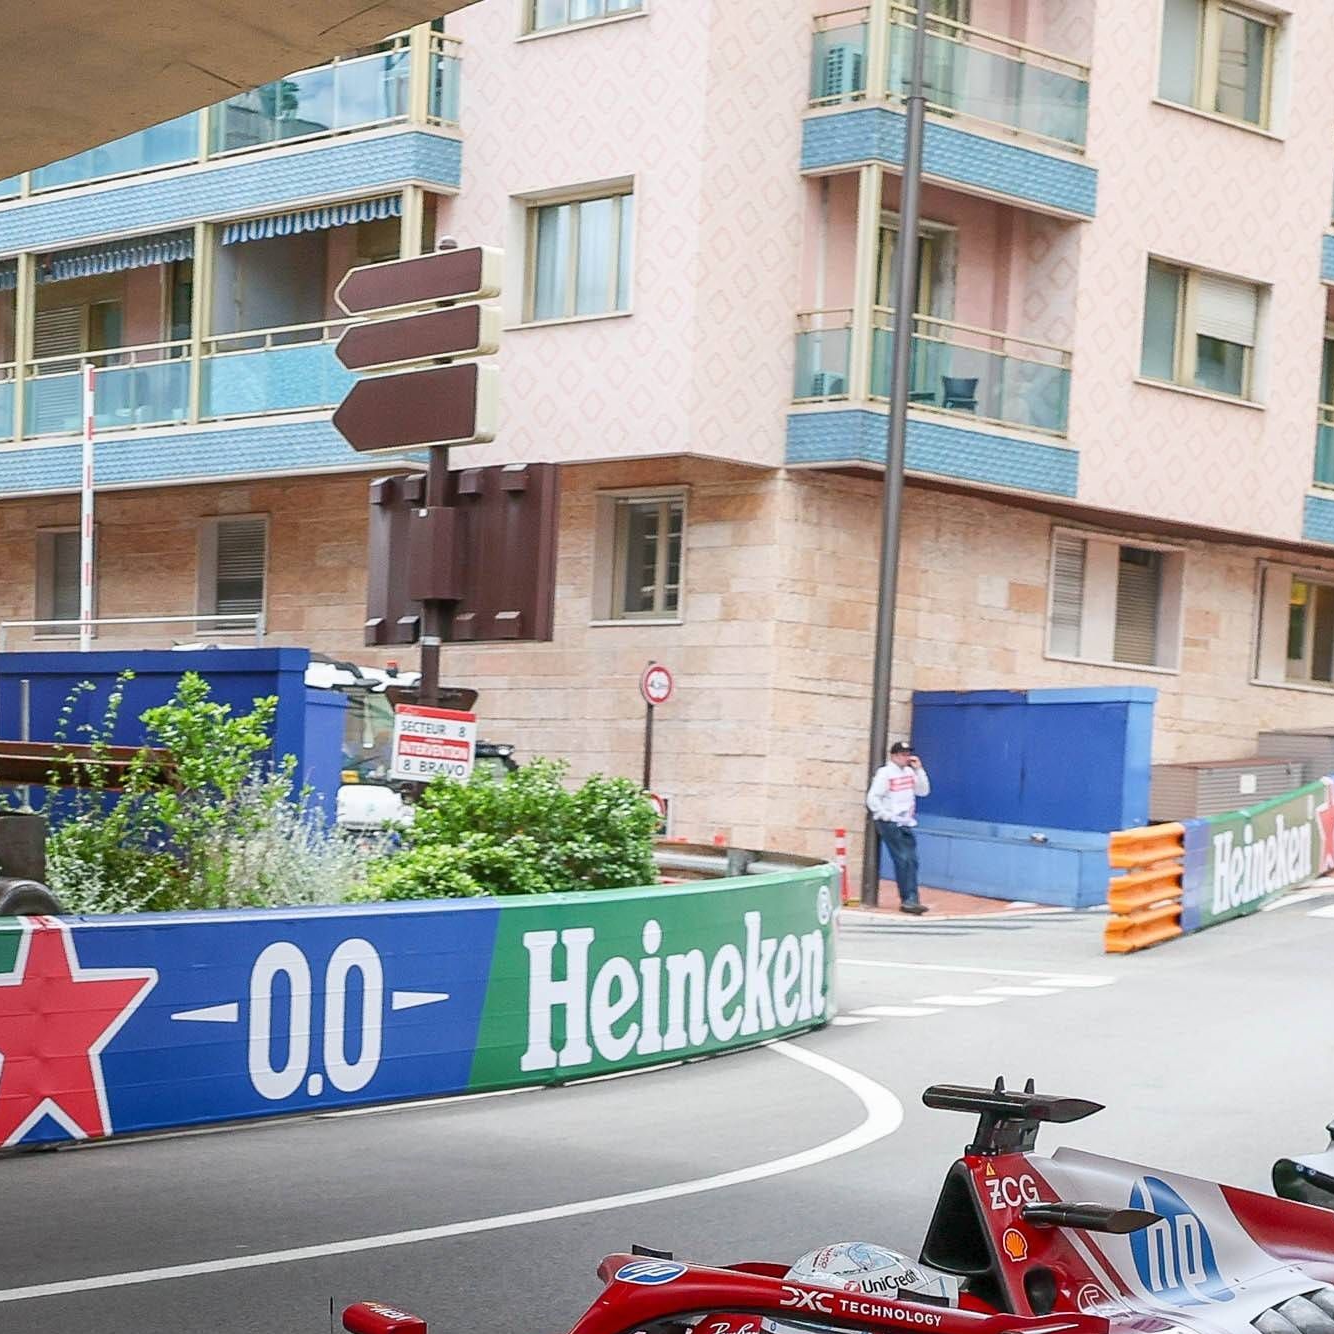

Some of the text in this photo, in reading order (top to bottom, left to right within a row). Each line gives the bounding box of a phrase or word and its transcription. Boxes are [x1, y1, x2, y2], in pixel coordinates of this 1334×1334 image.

[401, 720, 447, 736] SECTEUR
[403, 760, 465, 776] 8 BRAVO
[1212, 814, 1313, 916] Heineken
[247, 938, 384, 1098] 0.0
[861, 1269, 920, 1294] UniCredit
[780, 1286, 943, 1326] DXC TECHNOLOGY
